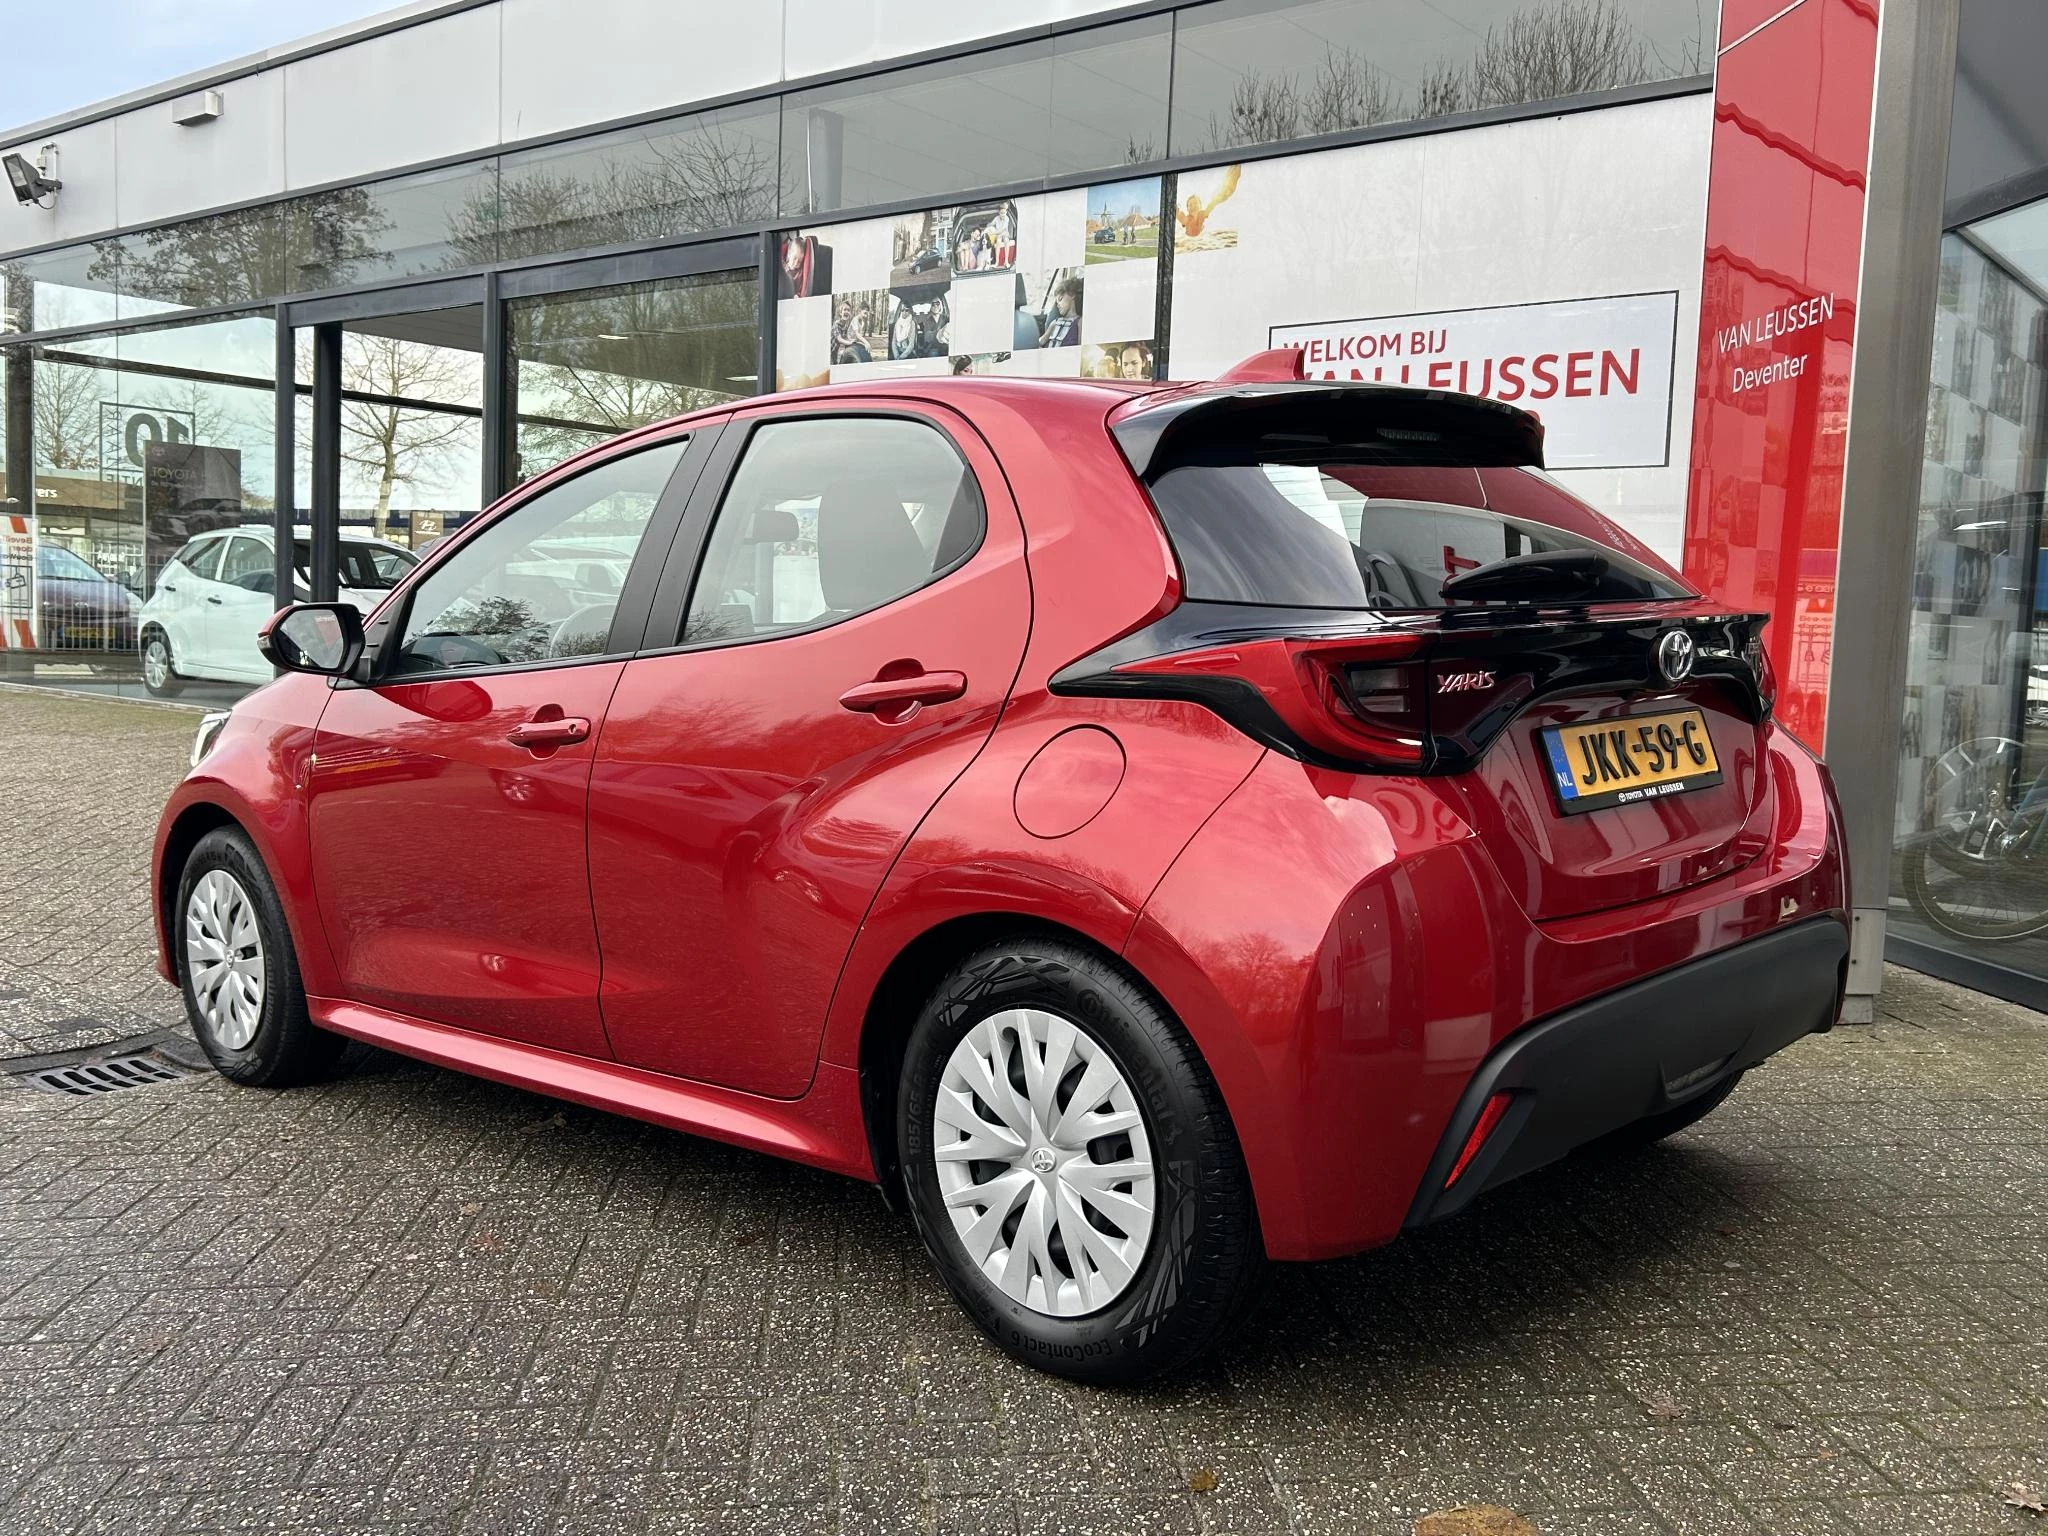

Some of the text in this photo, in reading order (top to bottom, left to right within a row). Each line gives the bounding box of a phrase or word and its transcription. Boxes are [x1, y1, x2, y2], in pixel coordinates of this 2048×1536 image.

[1718, 292, 1834, 354] VAN LEUSSEN
[1410, 329, 1447, 355] BIJ
[1732, 354, 1808, 393] Deventer
[152, 466, 197, 480] TOYOTA
[1437, 670, 1497, 694] YARIS
[1579, 719, 1707, 785] JKK-59-G
[1557, 772, 1573, 788] NL
[1625, 782, 1685, 801] TOYOTA VAN LEUSSEN
[1077, 988, 1176, 1121] Contiental
[1010, 1330, 1113, 1362] EcoContact 6
